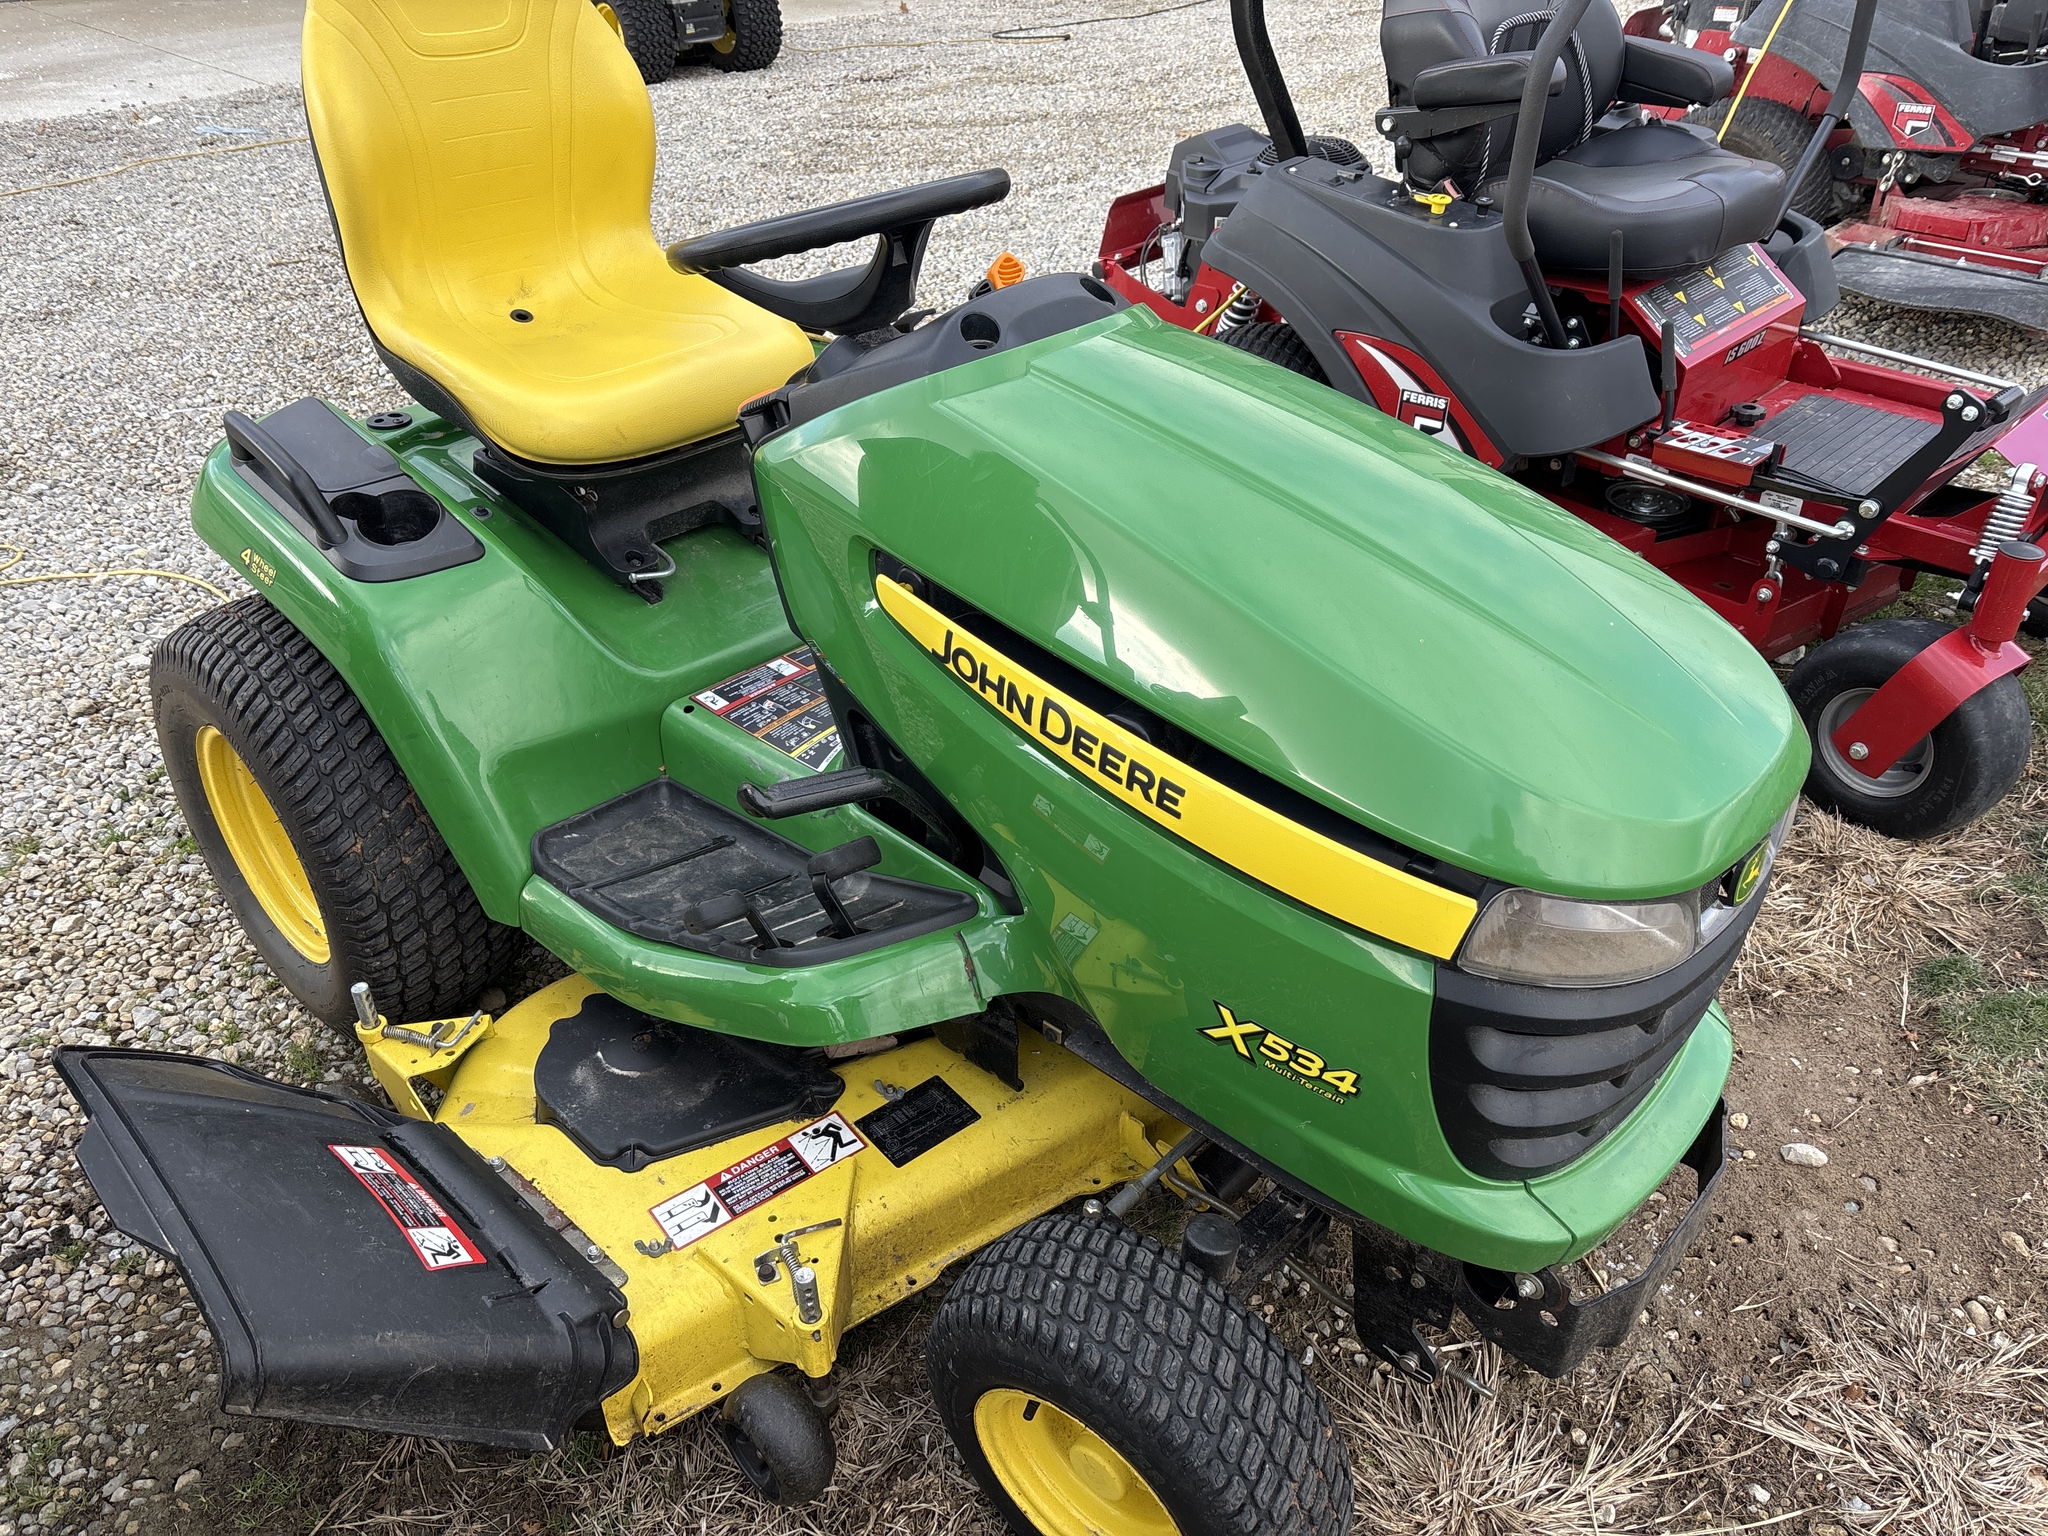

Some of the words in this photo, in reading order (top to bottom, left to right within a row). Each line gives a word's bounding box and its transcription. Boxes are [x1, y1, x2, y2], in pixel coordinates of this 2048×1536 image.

[1899, 104, 1932, 114] FERRIS
[1724, 347, 1739, 364] IS
[1737, 330, 1767, 357] 600Z
[1403, 391, 1446, 409] FERRIS
[241, 548, 252, 565] 4
[253, 553, 277, 578] Wheel
[251, 563, 273, 586] Steer
[931, 629, 1034, 726] JOHN
[1039, 696, 1186, 820] DEERE
[1203, 1004, 1358, 1095] X534
[1264, 1060, 1345, 1105] Multi-Terrain
[731, 1146, 779, 1174] DANGER
[415, 1190, 446, 1217] DANGER
